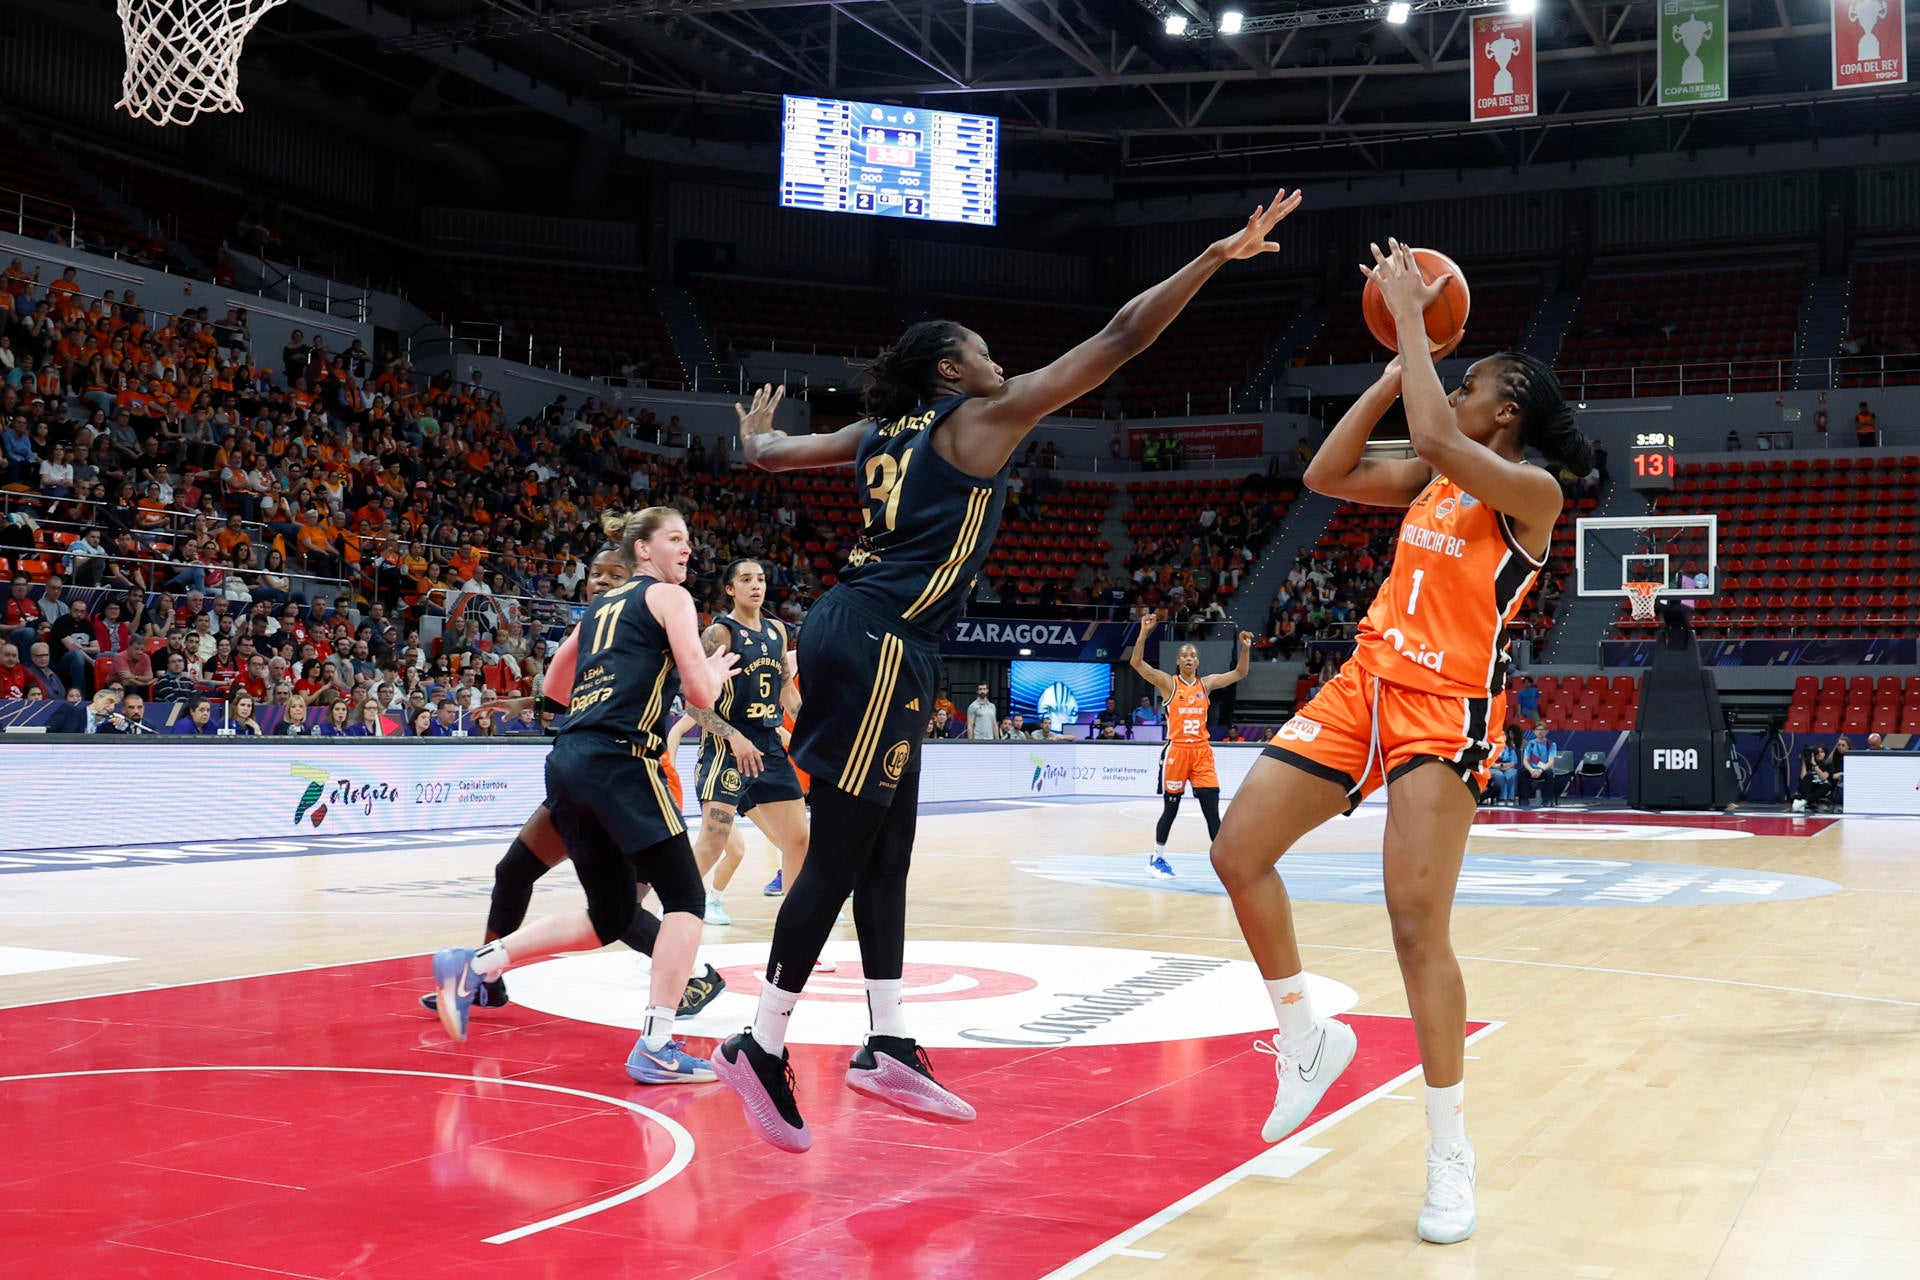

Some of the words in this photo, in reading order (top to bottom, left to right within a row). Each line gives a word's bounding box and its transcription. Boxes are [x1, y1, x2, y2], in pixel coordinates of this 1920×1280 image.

[1841, 63, 1863, 75] COPA
[1864, 61, 1880, 72] DEL
[1882, 59, 1898, 70] REY
[1478, 97, 1498, 109] COPA
[1499, 96, 1513, 106] DEL
[1515, 94, 1530, 104] REY
[1664, 86, 1688, 96] COPA
[866, 129, 886, 144] 38
[897, 131, 917, 147] 38
[858, 194, 870, 209] 2
[908, 199, 919, 213] 2
[1636, 433, 1665, 446] 3:50
[1633, 453, 1664, 476] 13
[1401, 523, 1446, 553] VALENCIA
[1444, 535, 1467, 558] BC
[1406, 568, 1425, 616] 1
[591, 598, 627, 655] 11
[956, 621, 1078, 646] ZARAGOZA
[759, 672, 772, 699] 5
[1182, 719, 1201, 735] 22
[1653, 748, 1698, 770] FIBA
[415, 782, 452, 804] 2027
